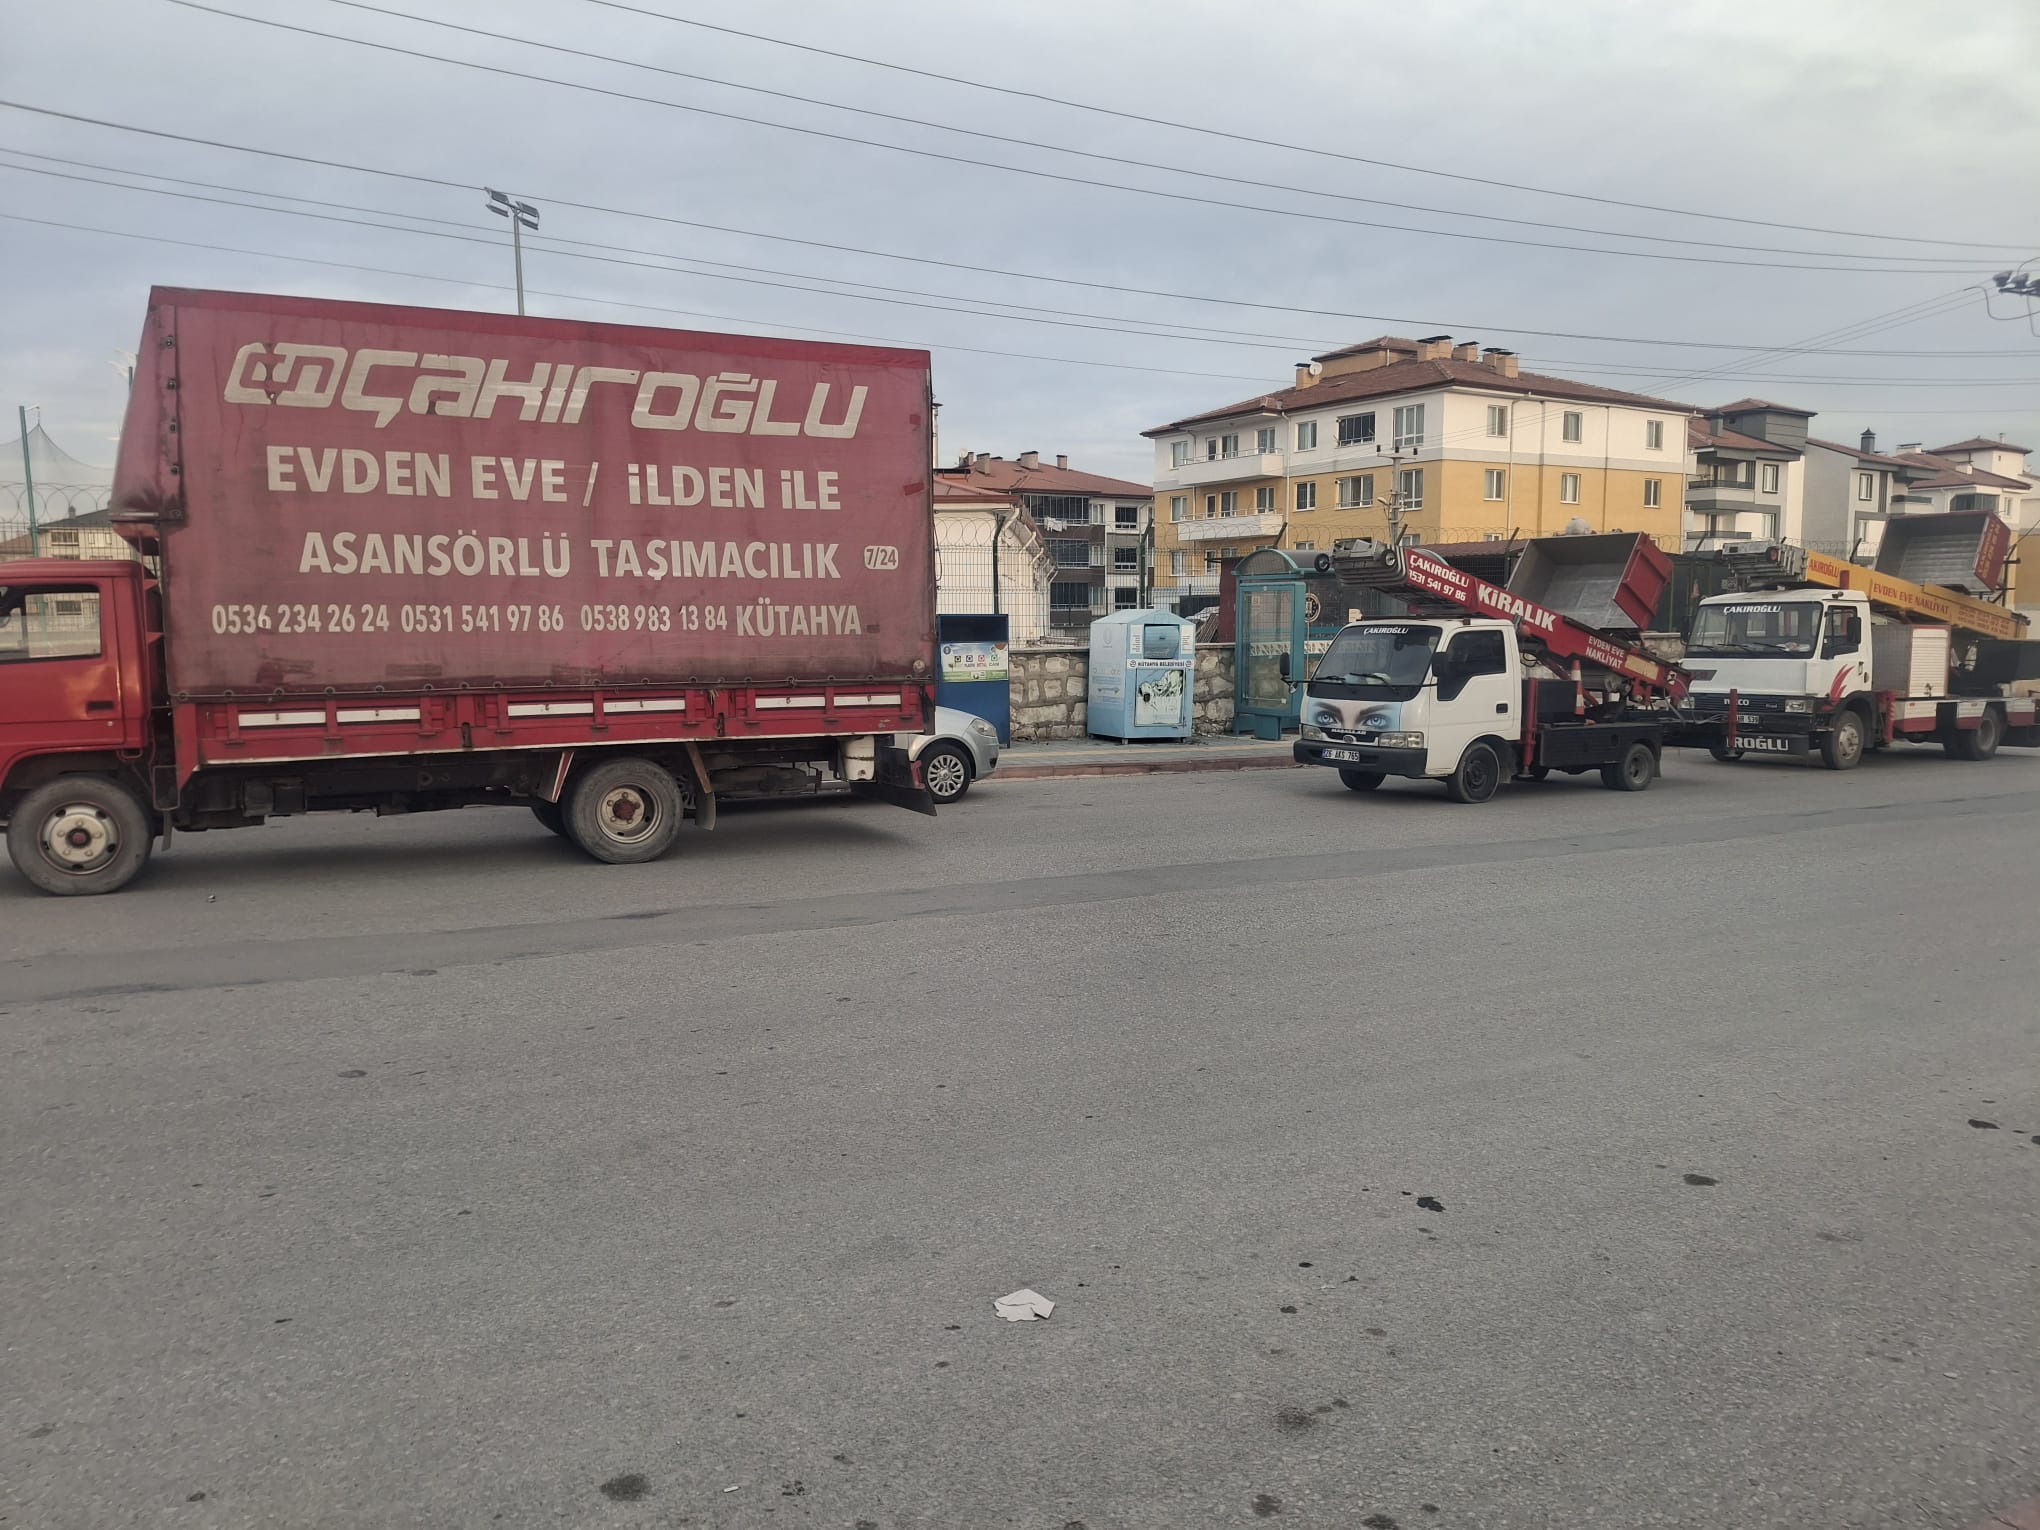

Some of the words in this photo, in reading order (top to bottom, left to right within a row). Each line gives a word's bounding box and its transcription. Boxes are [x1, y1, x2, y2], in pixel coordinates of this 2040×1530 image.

[266, 445, 451, 497] EVDEN
[471, 456, 567, 502] EVE
[299, 529, 570, 578] ASANSÖRLÜ
[590, 539, 841, 581] TAŞIMACILIK
[866, 547, 897, 567] 7/24
[1409, 554, 1470, 588] ÇAKIROĞLU
[1809, 560, 1840, 578] AKIROĞLU
[1426, 577, 1442, 592] 541
[1442, 585, 1455, 597] 97
[1455, 590, 1467, 602] 86
[1873, 583, 1898, 599] EVDEN
[212, 604, 272, 634] 0536
[277, 604, 322, 633] 234
[327, 604, 355, 632] 26
[361, 604, 389, 632] 24
[401, 604, 453, 633] 0531
[461, 605, 500, 632] 541
[507, 605, 532, 632] 97
[538, 605, 564, 632] 86
[580, 605, 630, 631] 0538
[634, 605, 671, 632] 983
[680, 605, 699, 631] 13
[705, 605, 728, 631] 84
[736, 597, 862, 637] KÜTAHYA
[1478, 583, 1557, 633] KİRALIK
[1723, 605, 1782, 616] ÇAKIROĞLU
[1363, 626, 1409, 636] ÇAKIROĞLU
[1588, 635, 1612, 652] EVDEN
[1611, 645, 1625, 658] EVE
